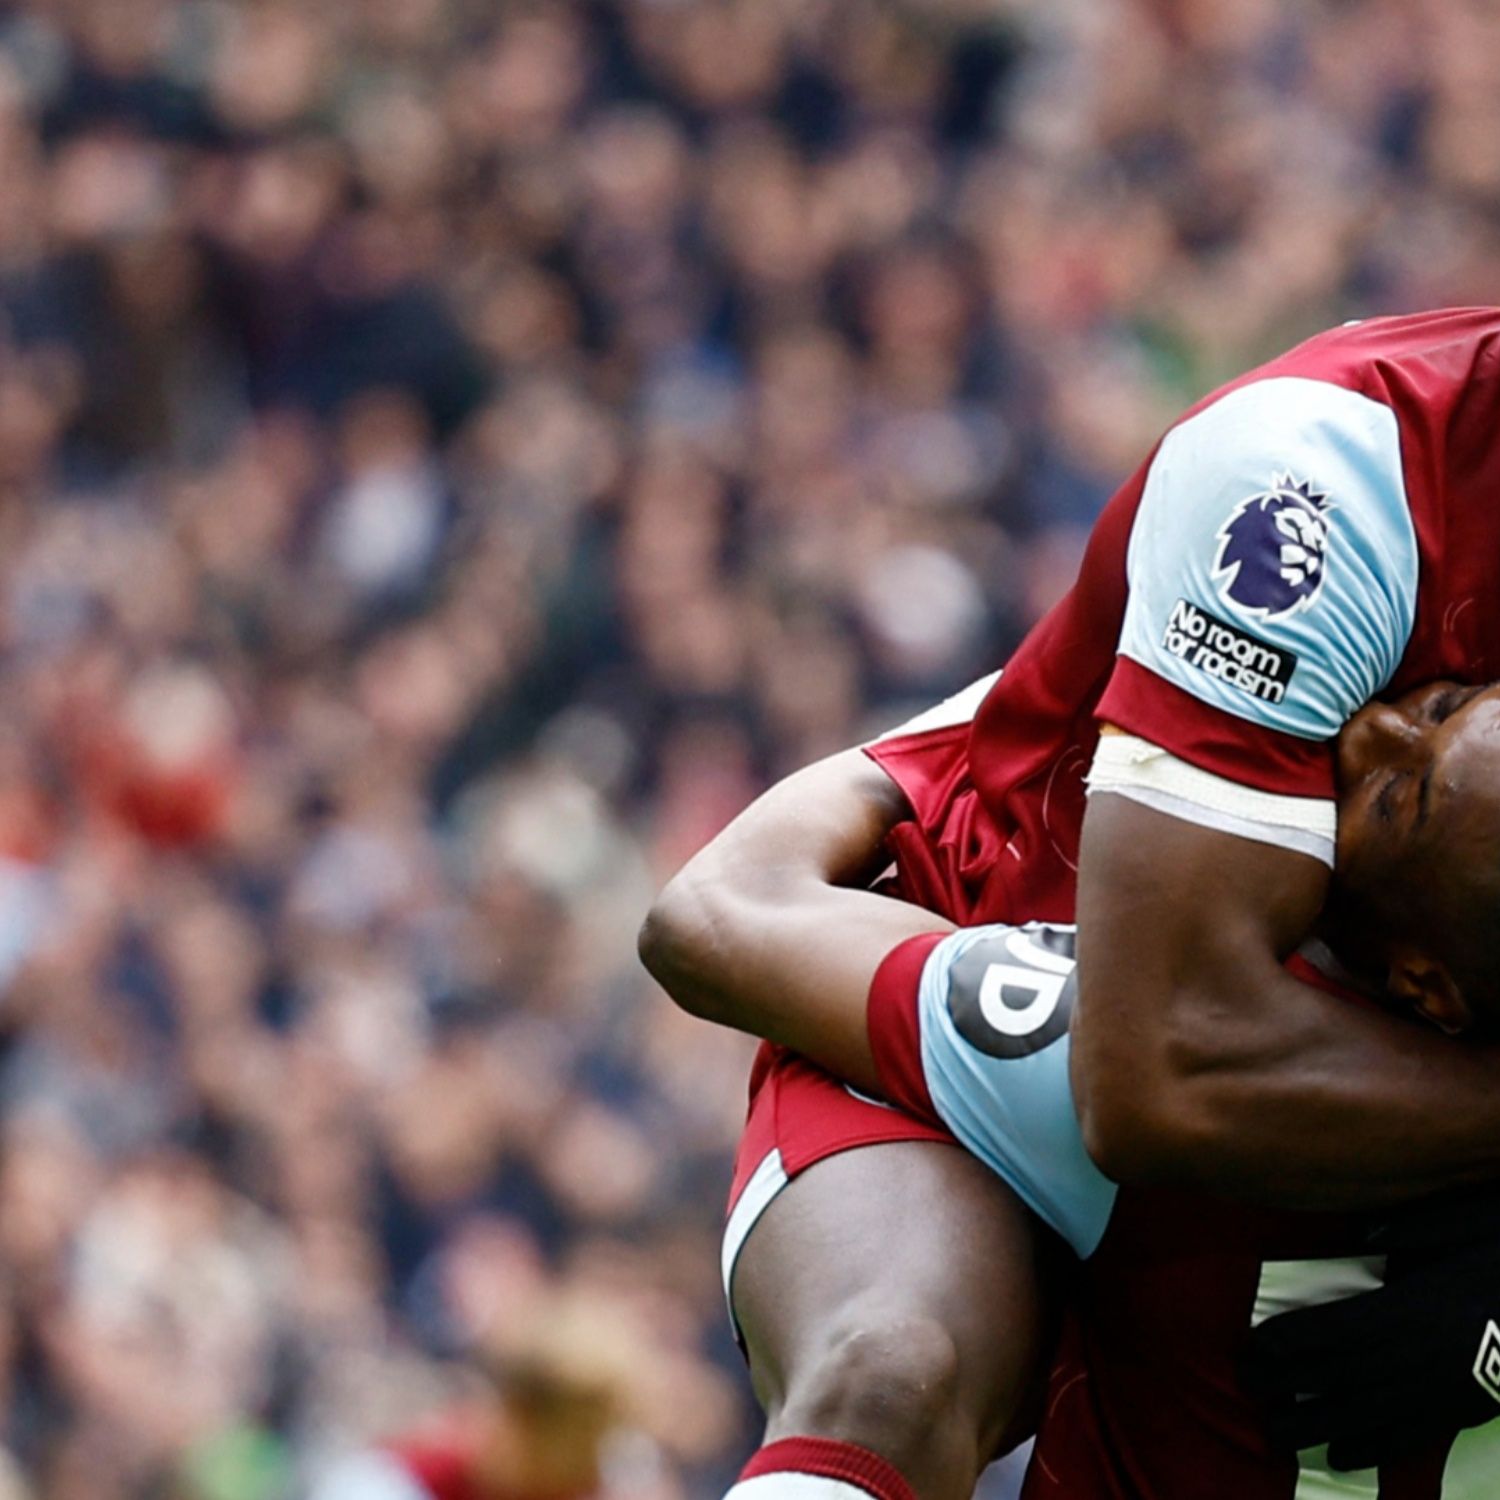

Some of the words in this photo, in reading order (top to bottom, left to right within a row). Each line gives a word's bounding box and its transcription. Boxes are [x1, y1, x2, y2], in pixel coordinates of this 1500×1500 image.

[1162, 622, 1197, 657] for
[1194, 650, 1285, 703] racism
[1169, 600, 1206, 638] No
[1205, 625, 1281, 676] room
